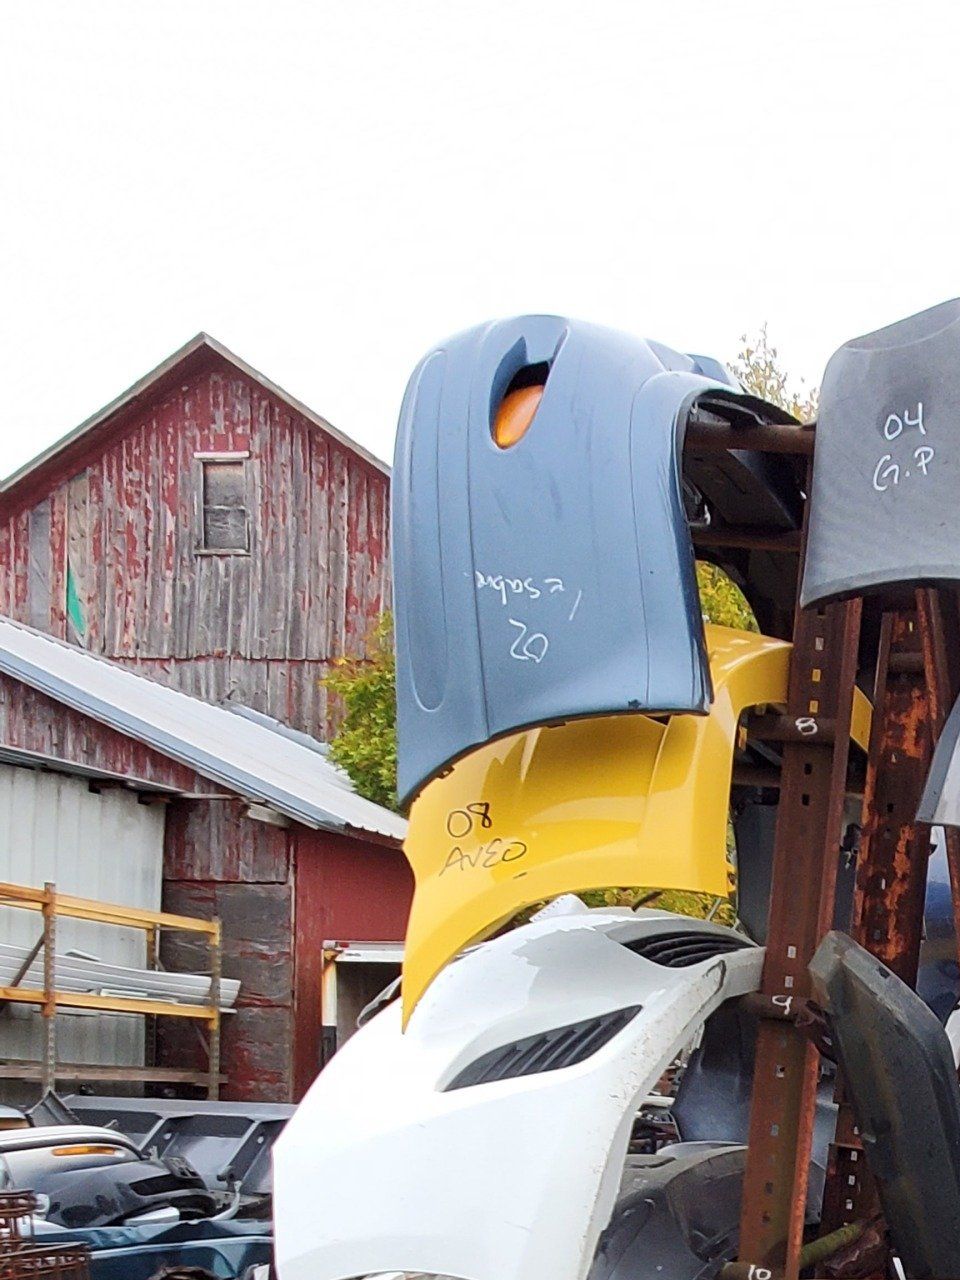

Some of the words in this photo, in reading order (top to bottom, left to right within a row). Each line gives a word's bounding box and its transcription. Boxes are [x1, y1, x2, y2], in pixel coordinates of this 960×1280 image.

[883, 401, 927, 441] 04
[507, 618, 549, 664] 02
[794, 716, 818, 736] 8
[446, 801, 493, 838] 08
[438, 837, 527, 877] AVEO
[771, 993, 794, 1016] 9
